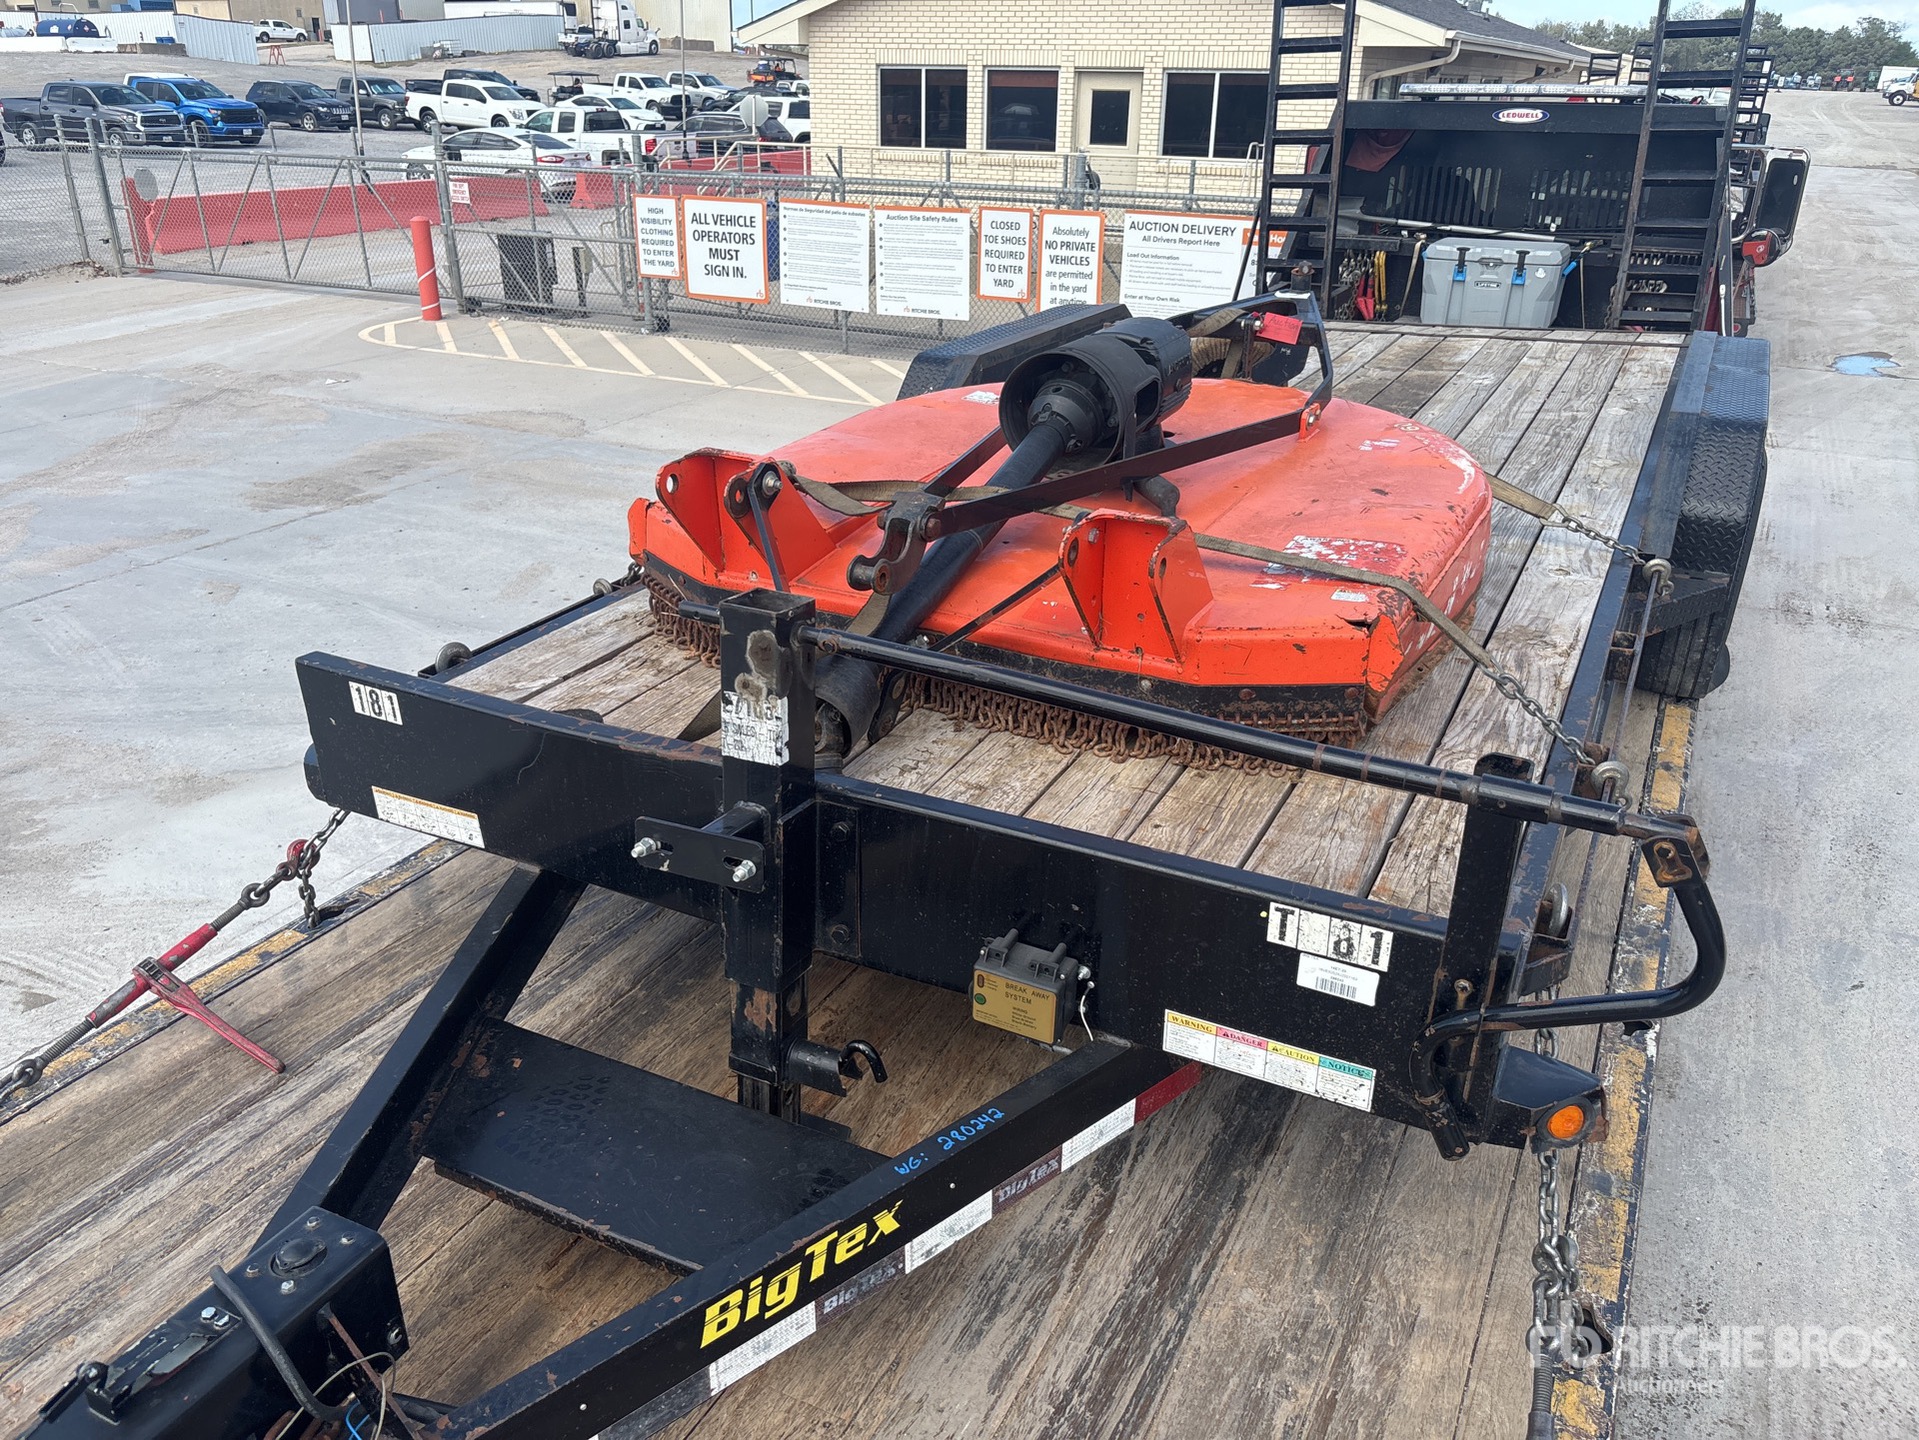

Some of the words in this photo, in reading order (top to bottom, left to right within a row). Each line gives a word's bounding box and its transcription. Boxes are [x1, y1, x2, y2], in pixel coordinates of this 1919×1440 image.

[648, 207, 664, 215] HIGH
[804, 207, 825, 215] Seguridad
[640, 217, 673, 226] VISIBILITY
[691, 212, 710, 225] ALL
[712, 213, 757, 228] VEHICLE
[886, 214, 909, 222] Auction
[910, 214, 921, 222] Site
[922, 215, 940, 224] Safety
[990, 220, 1021, 231] CLOSED
[1129, 220, 1179, 234] AUCTION
[1182, 224, 1237, 237] DELIVERY
[641, 227, 674, 237] CLOTHING
[692, 229, 756, 246] OPERATORS
[1052, 226, 1090, 239] Absolutely
[641, 238, 675, 247] REQUIRED
[984, 234, 999, 244] TOE
[1001, 235, 1027, 246] SHOES
[1044, 240, 1058, 250] NO
[1060, 241, 1096, 252] PRIVATE
[1152, 236, 1177, 244] Drivers
[1178, 238, 1202, 247] Report
[643, 248, 652, 256] TO
[653, 249, 674, 258] ENTER
[709, 247, 741, 262] MUST
[985, 249, 1025, 260] REQUIRED
[644, 258, 657, 266] THE
[657, 259, 675, 268] YARD
[1049, 254, 1090, 266] VEHICLES
[704, 263, 730, 278] SIGN
[732, 266, 748, 279] IN.
[986, 263, 997, 273] TO
[998, 264, 1023, 275] ENTER
[1045, 270, 1057, 278] are
[1058, 271, 1093, 281] permitted
[993, 279, 1014, 288] YARD
[1050, 282, 1057, 291] in
[1059, 283, 1070, 292] the
[1071, 284, 1088, 295] yard
[1058, 297, 1087, 306] anytime
[1268, 316, 1300, 330] Auction
[355, 686, 398, 722] 181
[1274, 906, 1296, 942] T
[1005, 982, 1028, 994] BREAK
[1031, 990, 1050, 1001] AWAY
[1005, 991, 1032, 1005] SYSTEM
[1172, 1015, 1213, 1033] WARNING
[1230, 1033, 1263, 1047] DANGER
[1278, 1047, 1315, 1062] CAUTION
[1328, 1060, 1364, 1077] NOTICE
[894, 1152, 929, 1174] WG:
[937, 1108, 1005, 1150] 280242
